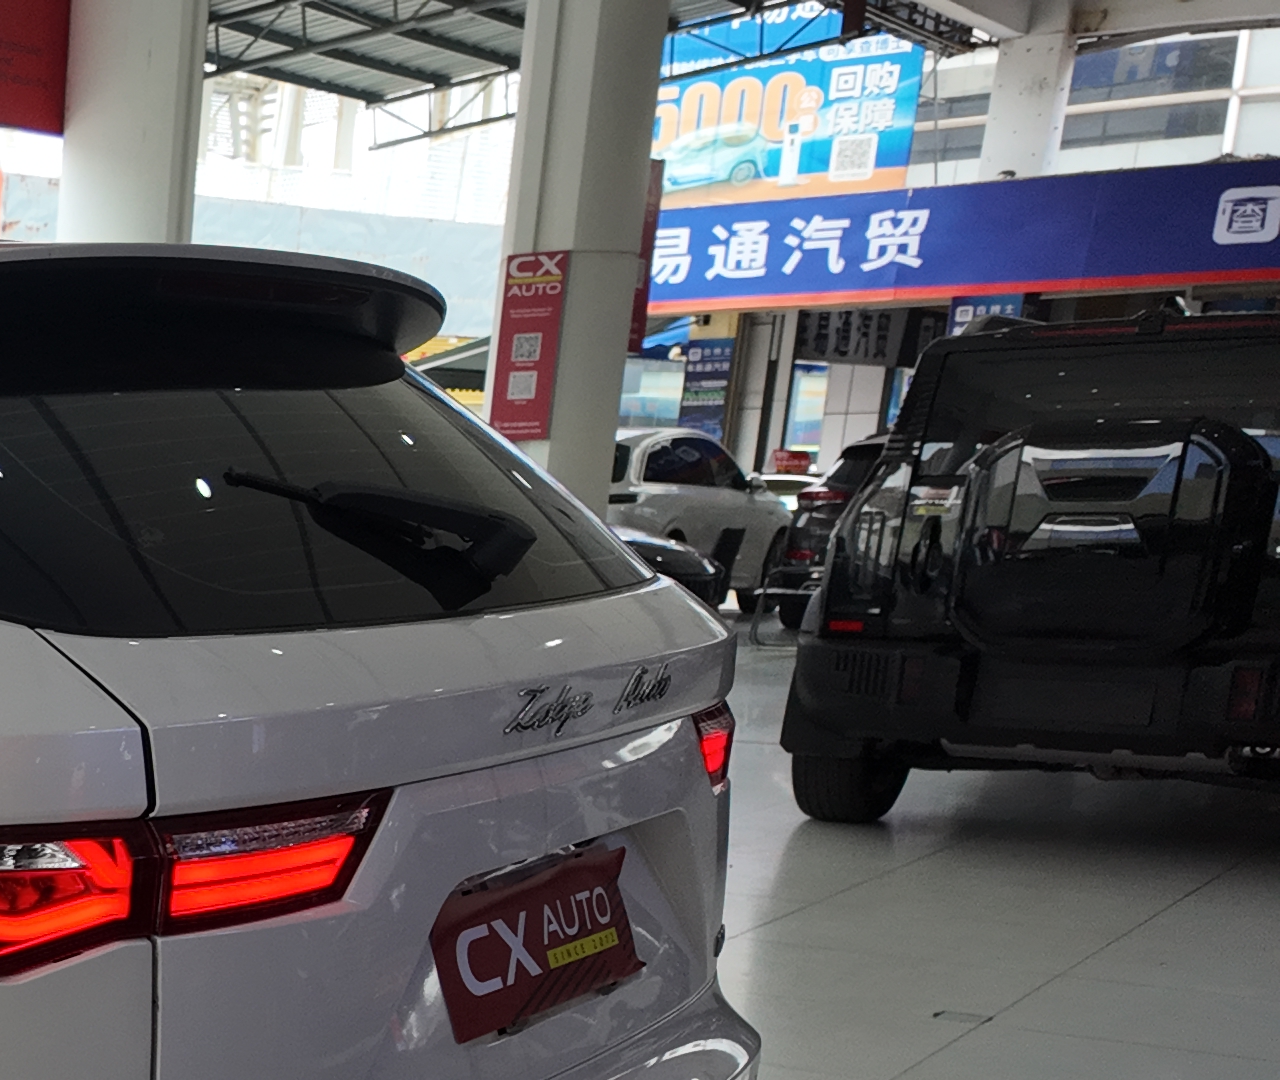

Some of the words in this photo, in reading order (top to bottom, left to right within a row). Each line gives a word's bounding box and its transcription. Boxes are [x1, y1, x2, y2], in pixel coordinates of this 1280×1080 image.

[828, 61, 901, 100] 回购
[825, 98, 896, 138] 保障
[508, 253, 564, 278] CX
[651, 208, 930, 285] 易通汽贸
[507, 282, 561, 298] AUTO
[455, 911, 543, 997] CX
[543, 886, 612, 945] AUTO
[553, 942, 586, 964] SINCE
